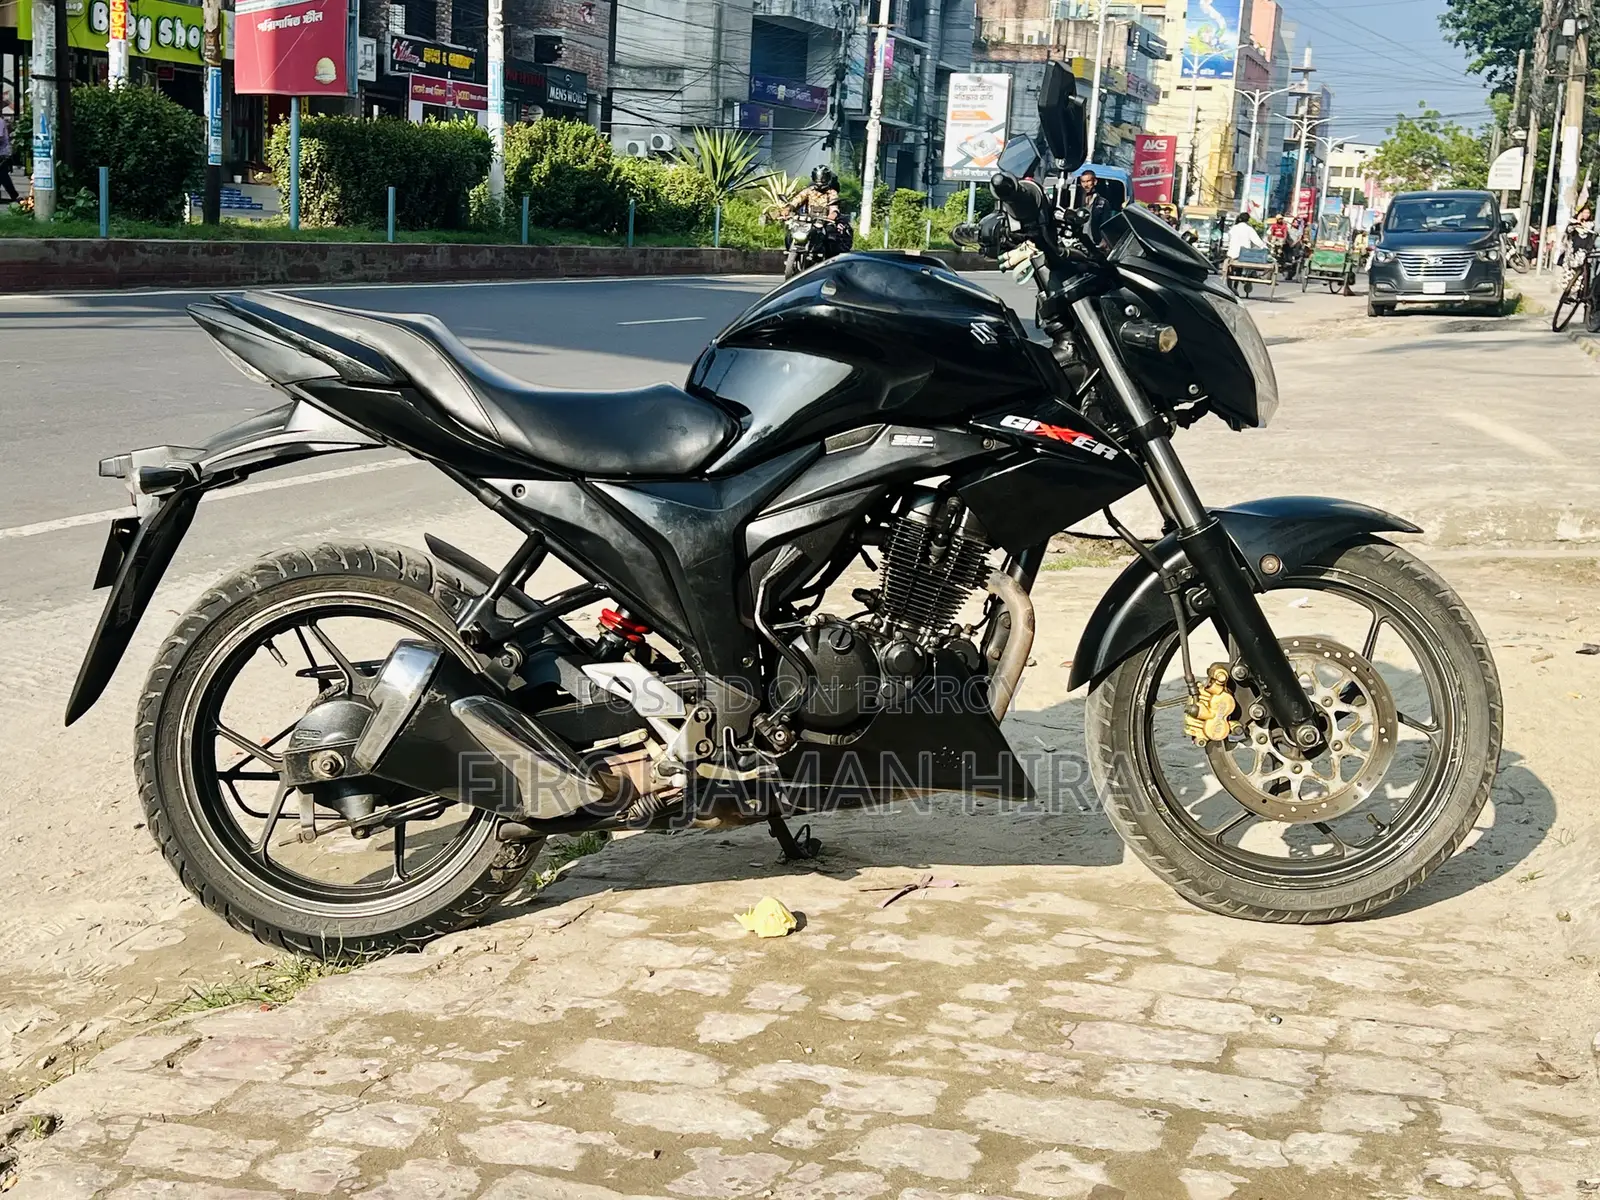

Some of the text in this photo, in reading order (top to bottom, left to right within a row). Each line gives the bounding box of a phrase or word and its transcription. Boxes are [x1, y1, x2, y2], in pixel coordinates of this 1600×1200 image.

[91, 1, 152, 53] Bby
[158, 15, 204, 58] Sho
[1143, 140, 1168, 150] AKS
[1000, 415, 1119, 460] GIXXER
